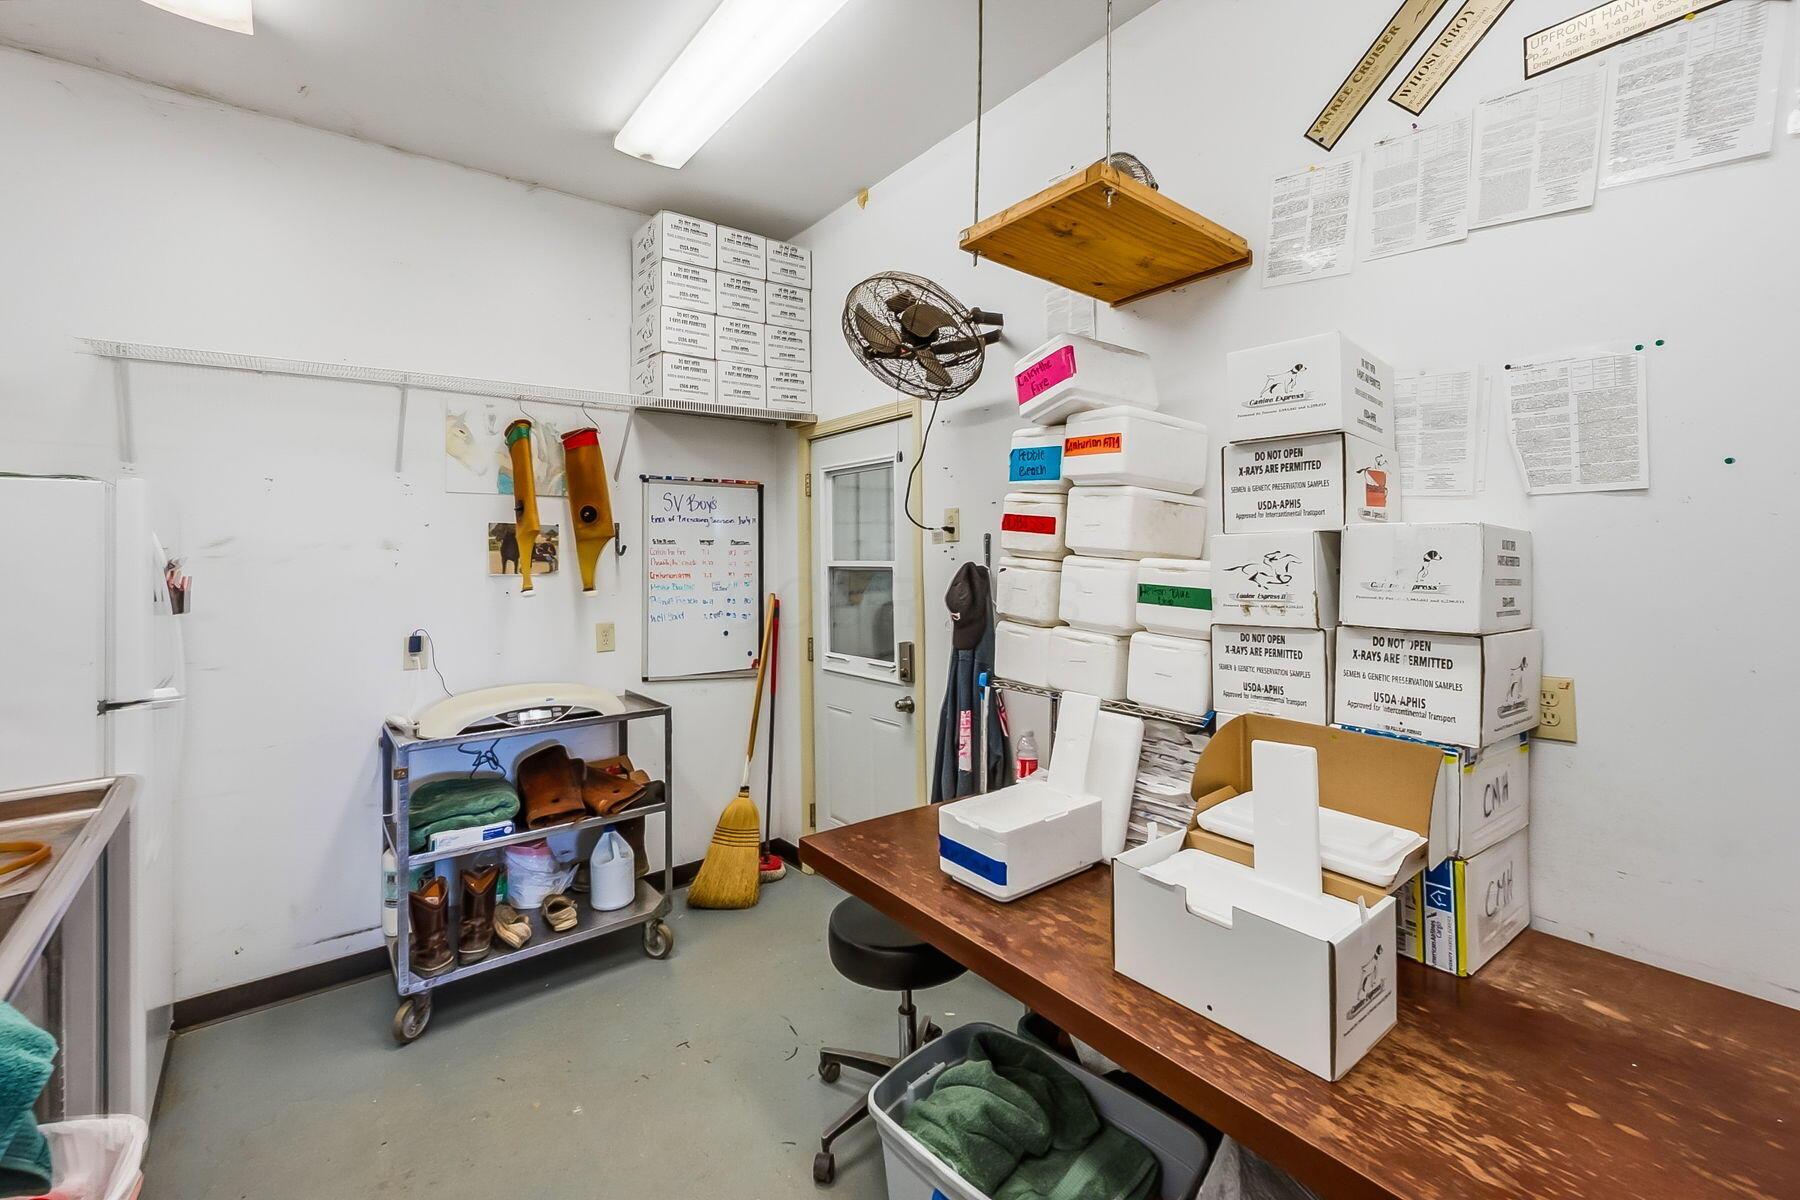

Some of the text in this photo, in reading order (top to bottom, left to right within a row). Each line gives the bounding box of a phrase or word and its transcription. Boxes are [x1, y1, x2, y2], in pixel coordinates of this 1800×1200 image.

[1530, 14, 1597, 50] UPFRONT
[1313, 86, 1354, 134] YANKEE
[1353, 25, 1401, 84] CRUISER
[1254, 447, 1303, 461] DO NOT OPEN
[1238, 460, 1321, 477] X-RAYS ARE PERMITTED
[1307, 479, 1330, 488] SAMPLES
[1257, 498, 1302, 511] USDA-APHIS
[1240, 632, 1286, 645] DO NOT OPEN
[1372, 635, 1385, 647] DO
[1387, 637, 1405, 649] NOT
[1225, 645, 1303, 660] X-RAYS ARE PERMITTED
[1352, 648, 1381, 662] X-RAYS
[1383, 652, 1400, 664] ARE
[1343, 669, 1361, 678] SEMEN
[1367, 672, 1391, 683] GENETIC
[1391, 675, 1434, 688] PRESERVATION
[1434, 681, 1463, 692] SAMPLES
[1242, 681, 1285, 696] USDA-APHIS
[1373, 691, 1427, 709] USDA-APHIS
[1346, 699, 1372, 711] Approved
[1373, 703, 1381, 711] for
[1428, 711, 1457, 723] Transport
